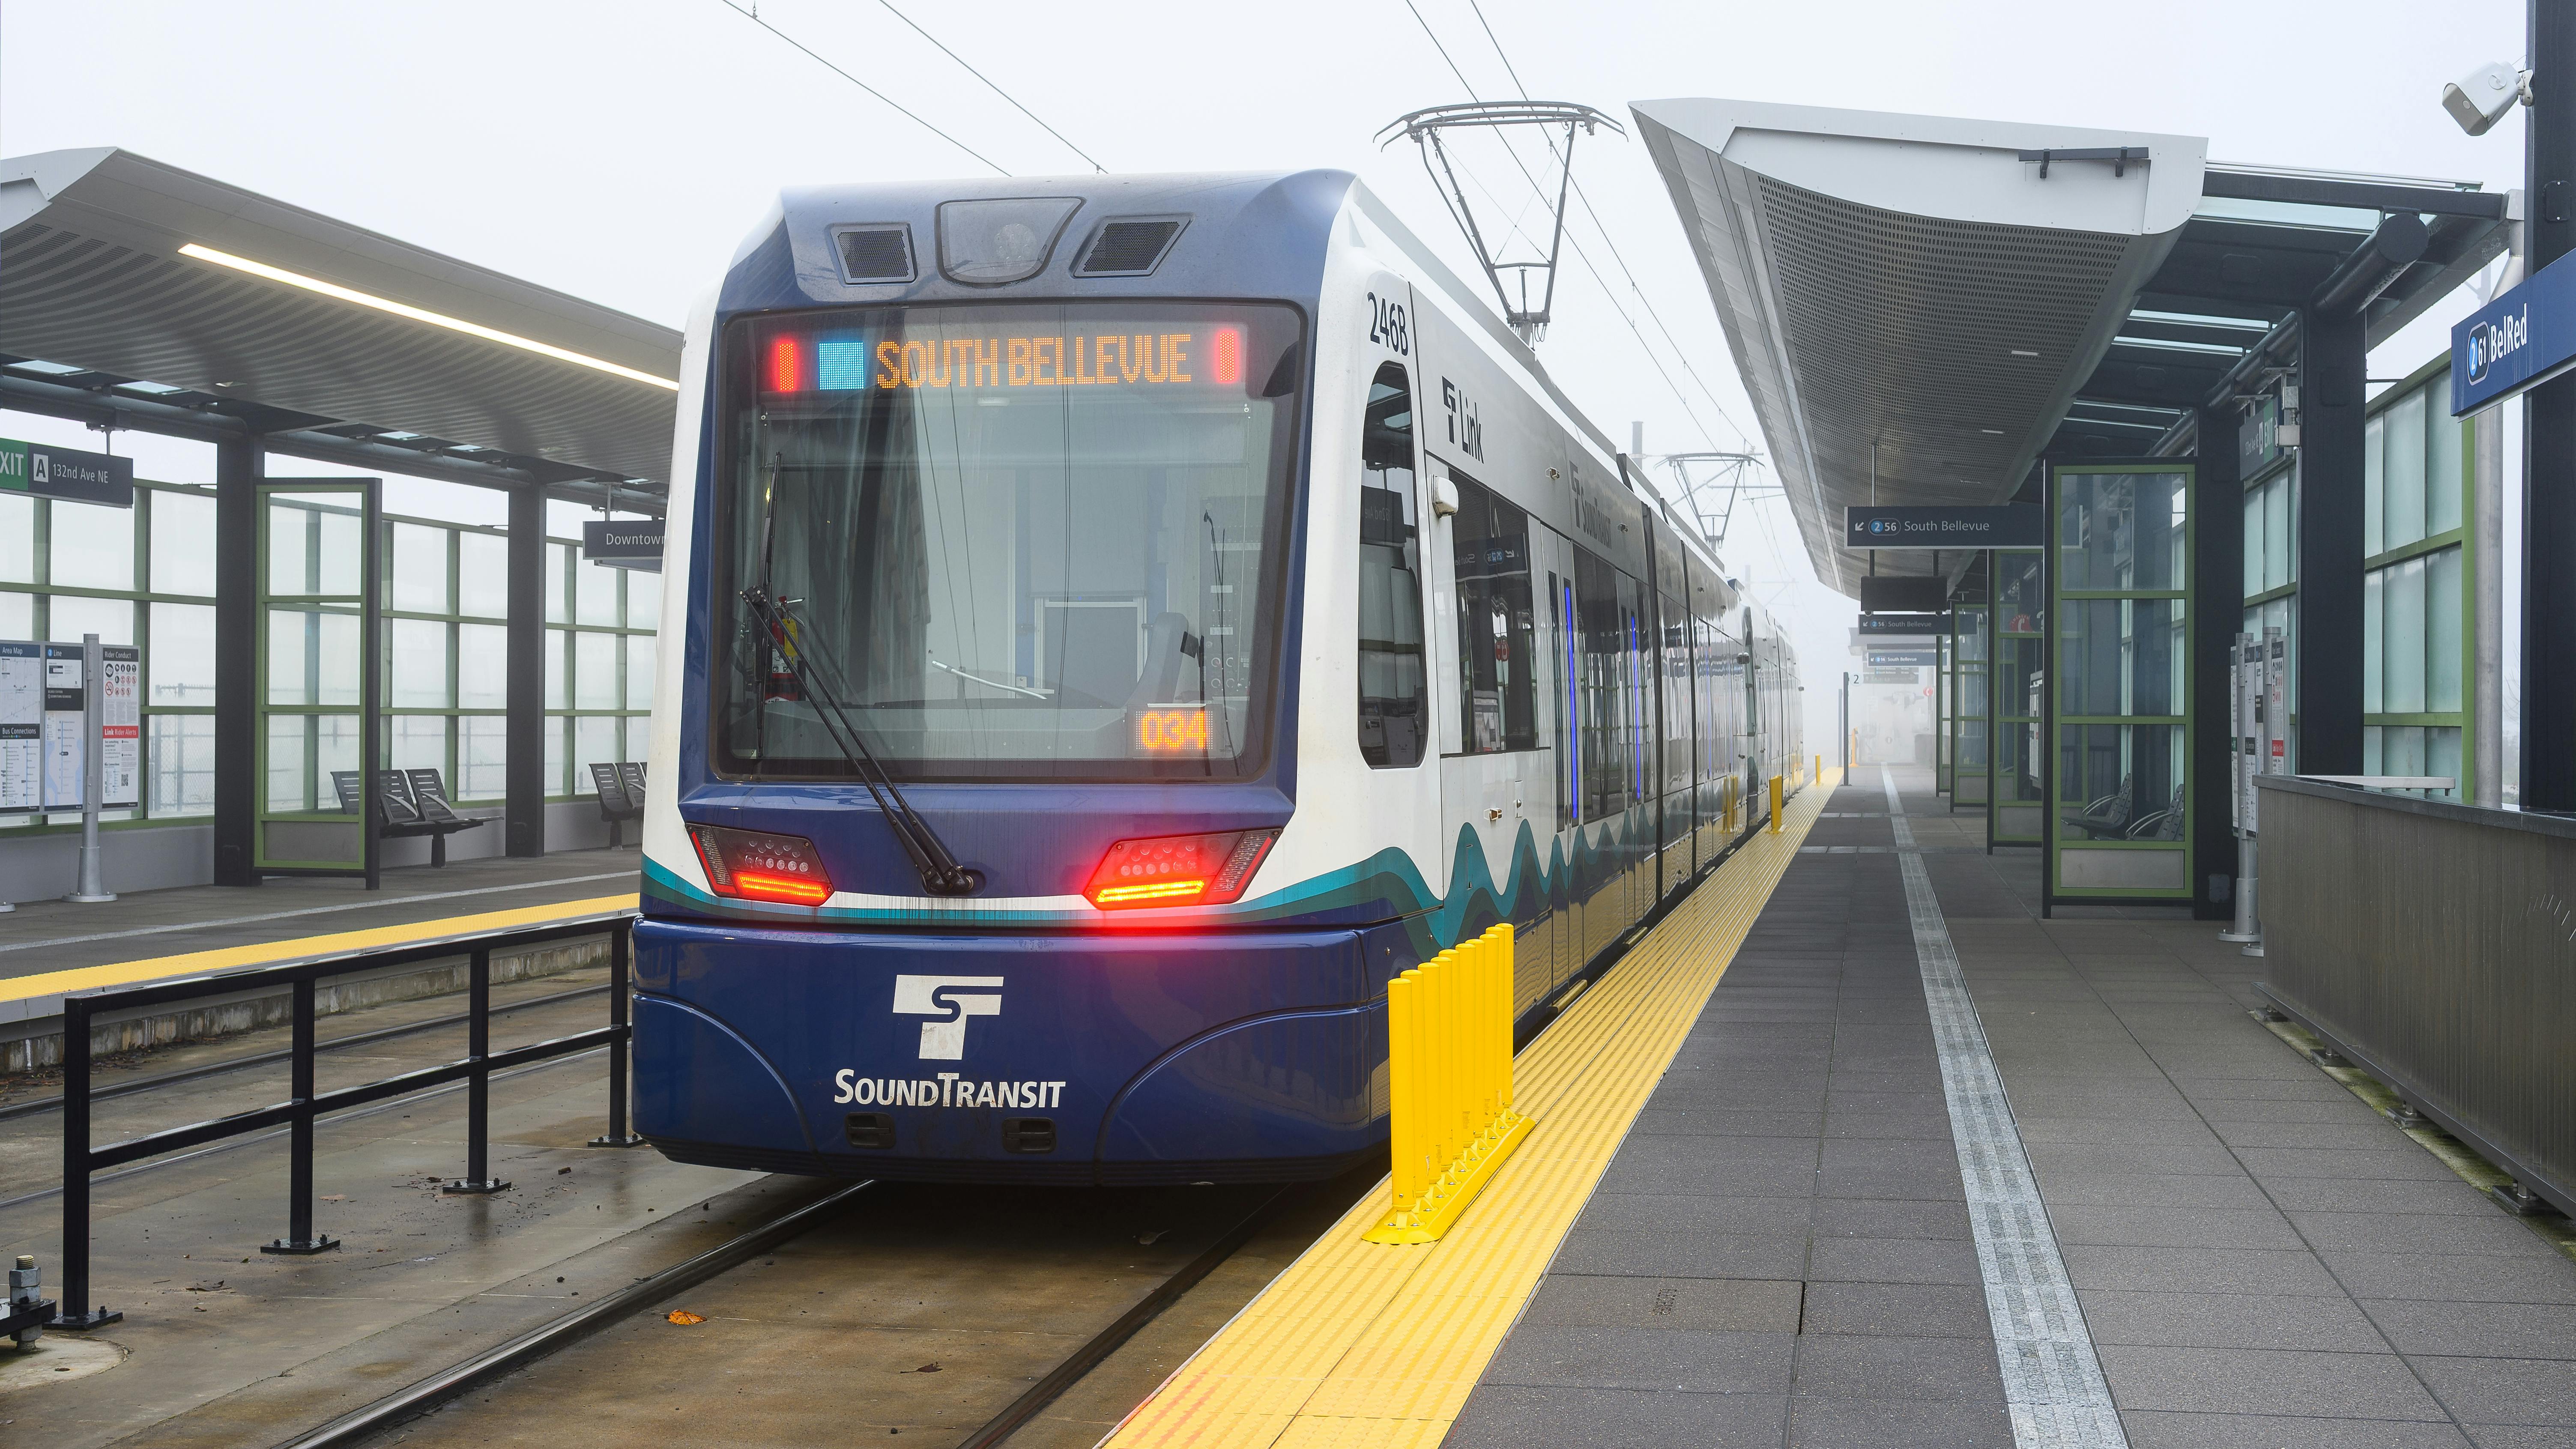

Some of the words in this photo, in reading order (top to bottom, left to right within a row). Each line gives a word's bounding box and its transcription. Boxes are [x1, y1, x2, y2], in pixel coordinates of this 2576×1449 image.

[1367, 291, 1408, 356] 246B
[2471, 342, 2476, 370] 2
[2478, 336, 2486, 367] 61
[2490, 302, 2527, 363] BelRed
[877, 339, 998, 388] SOUTH
[1008, 334, 1192, 386] BELLEVUE
[1458, 389, 1485, 464] Link
[0, 451, 24, 476] XIT
[36, 459, 46, 478] A
[53, 463, 78, 479] 132nd
[80, 467, 95, 482] Ave
[98, 470, 108, 484] NE
[1874, 523, 1880, 531] 2
[1885, 522, 1897, 531] 56
[1904, 520, 1937, 531] South
[1941, 520, 1990, 531] Bellevue
[2, 646, 12, 654] Area
[13, 647, 23, 656] Map
[1853, 674, 1859, 684] 2
[1142, 712, 1207, 748] 034
[834, 1069, 1066, 1108] SOUNDTRANSIT
